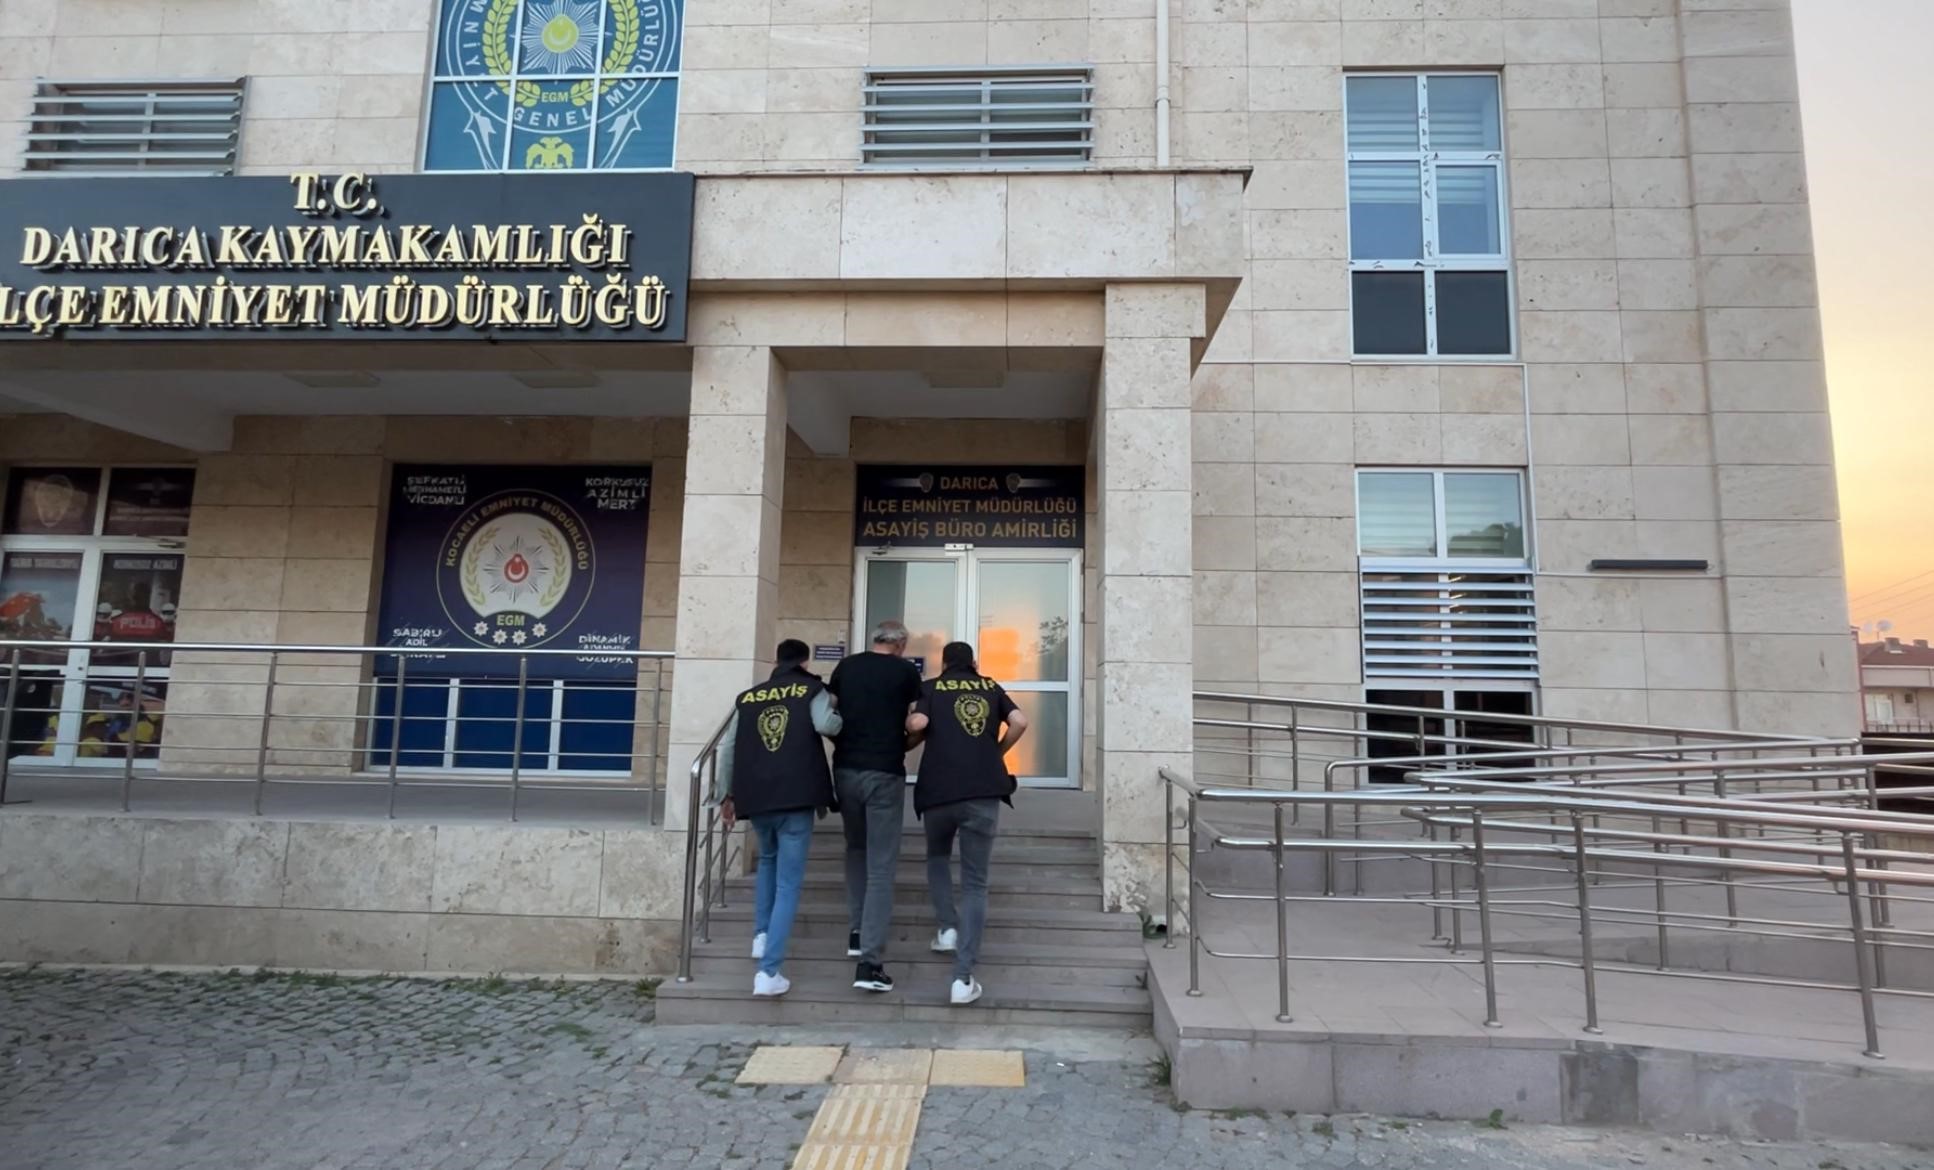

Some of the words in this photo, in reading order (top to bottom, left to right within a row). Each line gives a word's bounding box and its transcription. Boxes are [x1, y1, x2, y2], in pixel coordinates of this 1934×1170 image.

[541, 91, 569, 103] EGM
[290, 172, 377, 211] T.C.
[20, 225, 205, 265] DARICA
[216, 213, 628, 265] KAYMAKAMLIĞI
[0, 283, 86, 334] LÇE
[98, 275, 326, 325] EMNİYET
[337, 272, 666, 326] MÜDÜRLÜĞÜ
[586, 486, 646, 498] AZİMLİ
[940, 476, 999, 490] DARICA
[862, 496, 897, 516] İLÇE
[902, 496, 971, 513] EMNİYET
[975, 497, 1077, 514] MÜDÜRLÜĞÜ
[445, 513, 480, 567] KOCAELİ
[480, 496, 539, 517] EMNİYET
[540, 500, 589, 570] MÜDÜRLÜĞÜ
[863, 518, 929, 539] ASAYİŞ
[935, 518, 986, 538] BÜRO
[992, 518, 1077, 538] AMİRLİĞİ
[496, 614, 525, 626] EGM
[741, 682, 809, 704] ASAYİŞ
